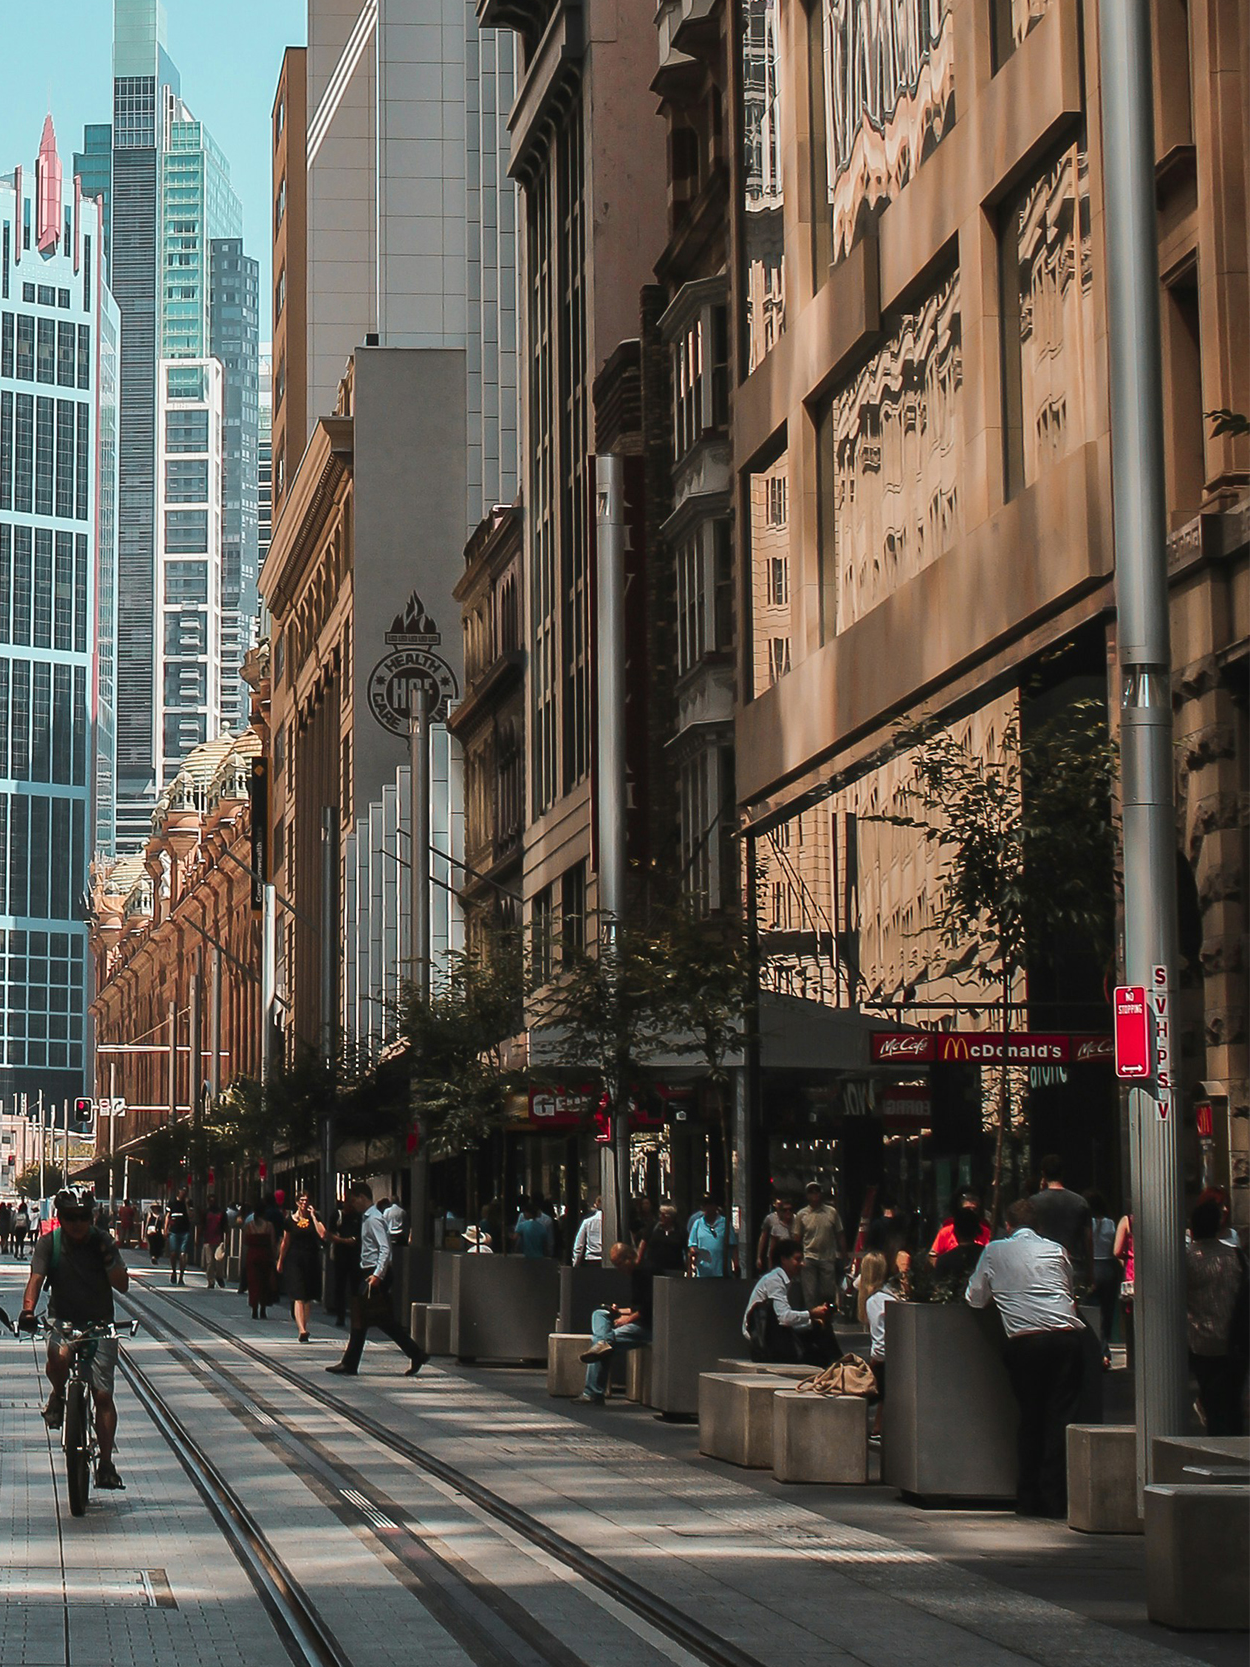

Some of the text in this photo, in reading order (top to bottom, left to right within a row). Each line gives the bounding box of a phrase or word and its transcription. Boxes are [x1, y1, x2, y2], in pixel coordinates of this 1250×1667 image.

[383, 653, 442, 674] HEALTH
[372, 692, 401, 730] CARE
[1124, 990, 1134, 1001] NO
[1118, 1004, 1142, 1014] STOPPING
